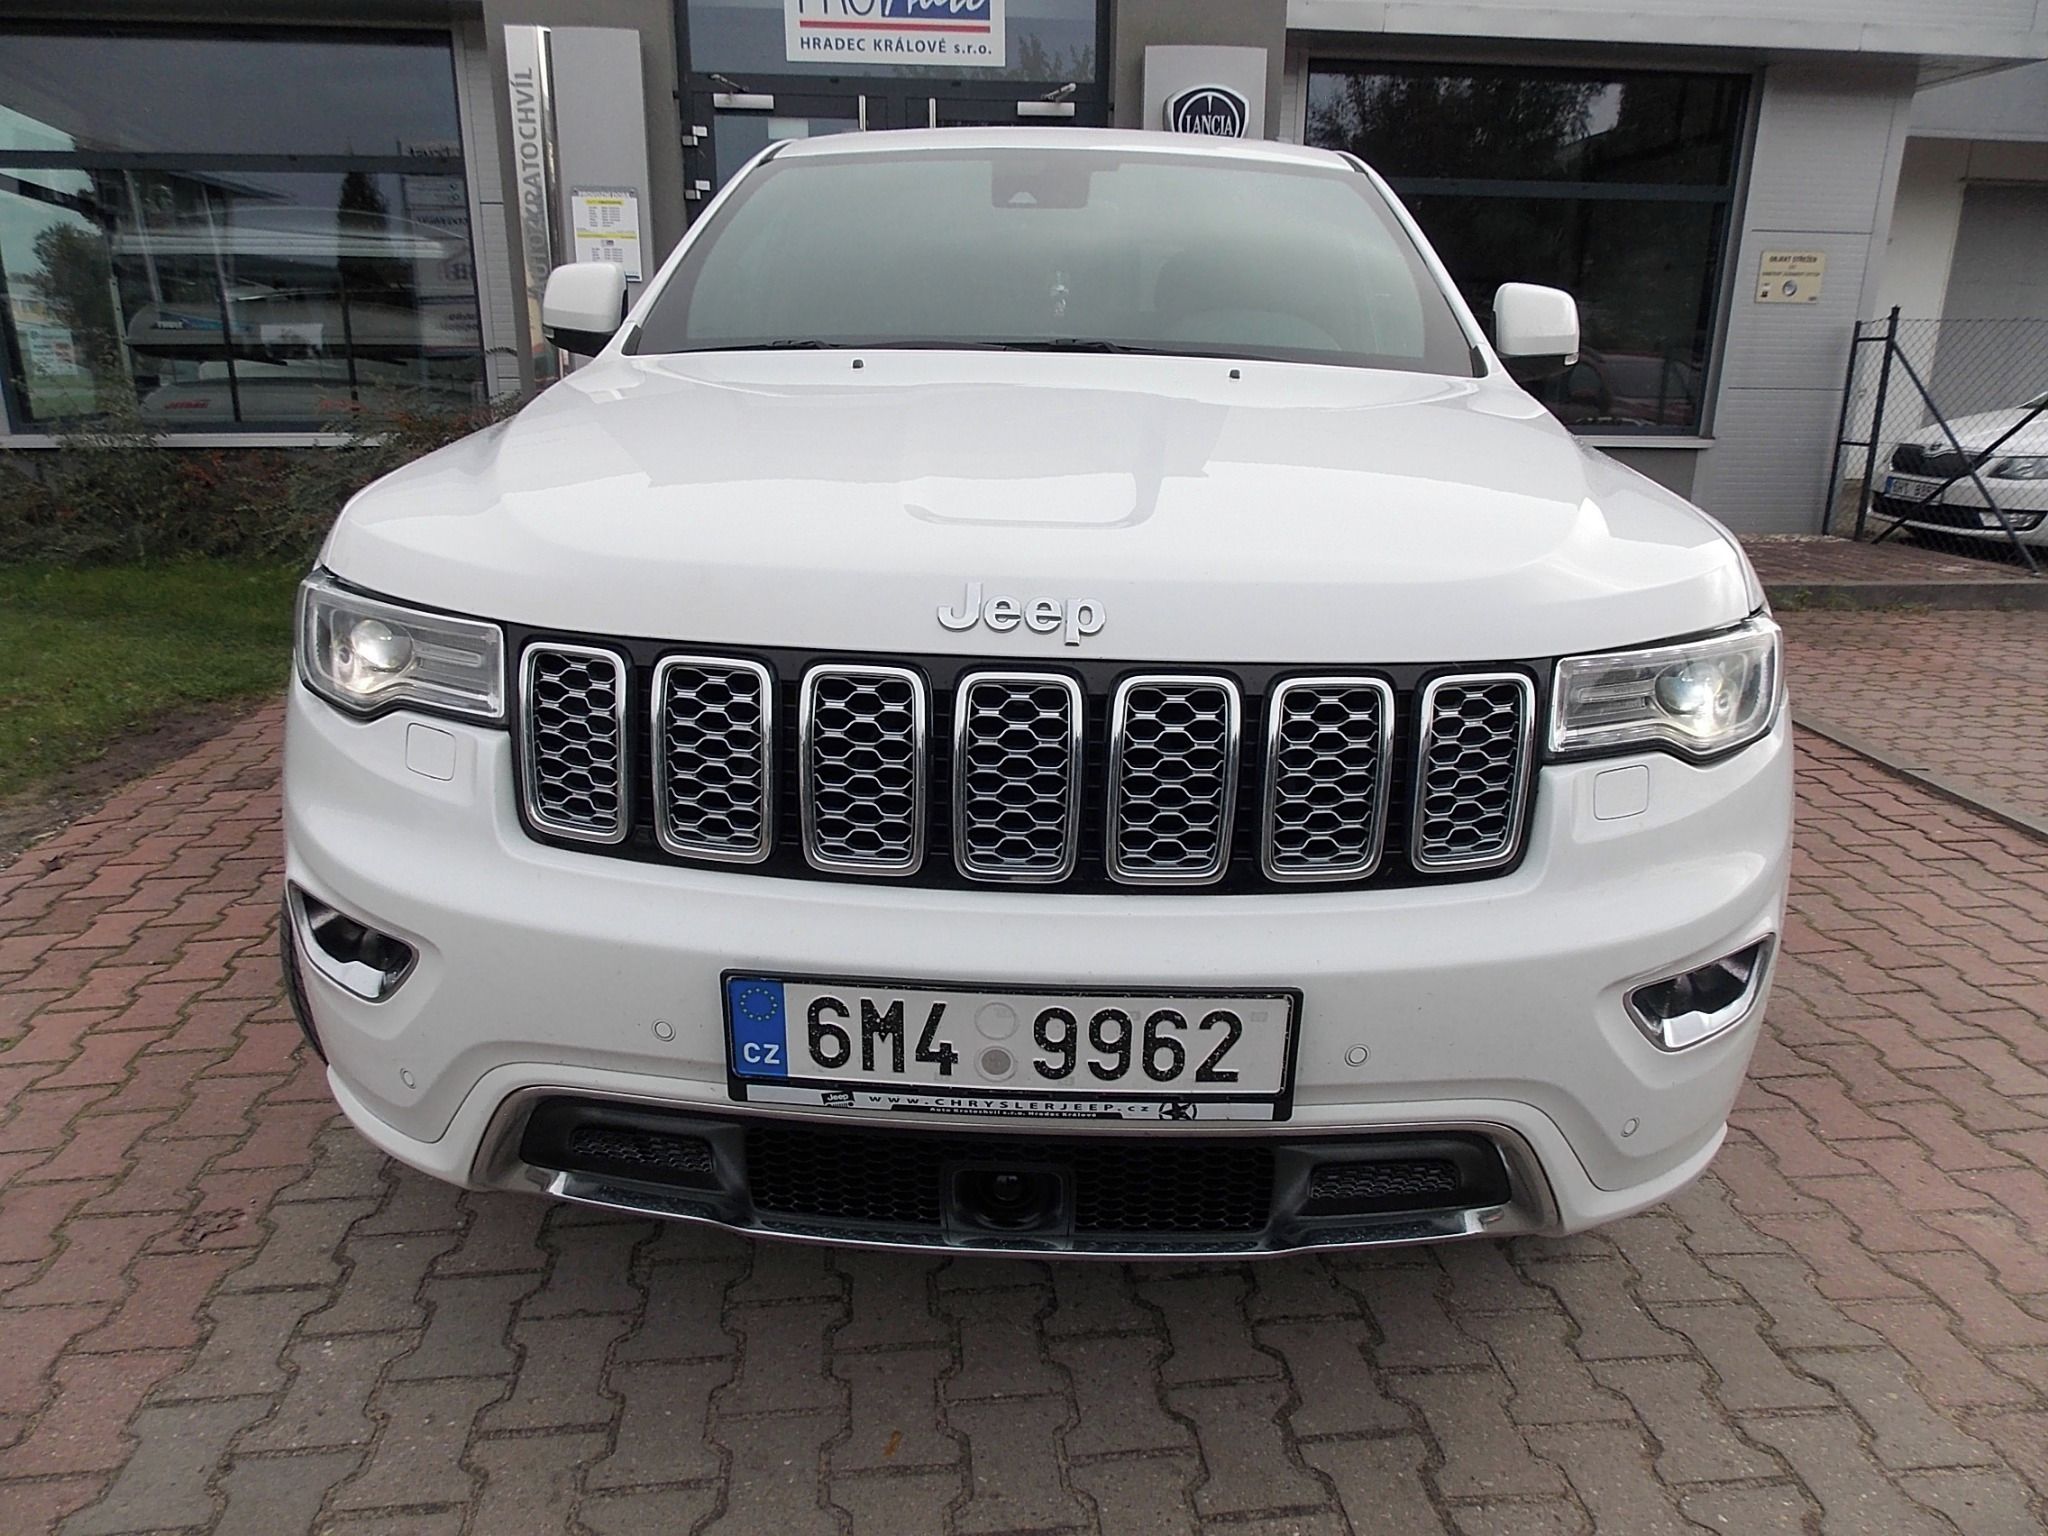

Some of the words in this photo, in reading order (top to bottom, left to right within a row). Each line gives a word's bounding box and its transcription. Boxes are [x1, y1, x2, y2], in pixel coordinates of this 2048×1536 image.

[800, 36, 866, 51] HRADEC
[873, 37, 946, 54] KRÁLOVÉ
[954, 43, 992, 55] s.r.o.
[1185, 114, 1233, 136] LANCIA
[937, 582, 1106, 646] Jeep
[806, 996, 960, 1076] 6M4
[1032, 1006, 1240, 1082] 9962
[743, 1042, 780, 1065] CZ
[827, 1093, 849, 1102] Jeep
[868, 1095, 1150, 1112] www.CHRYSLERJEEP.cz
